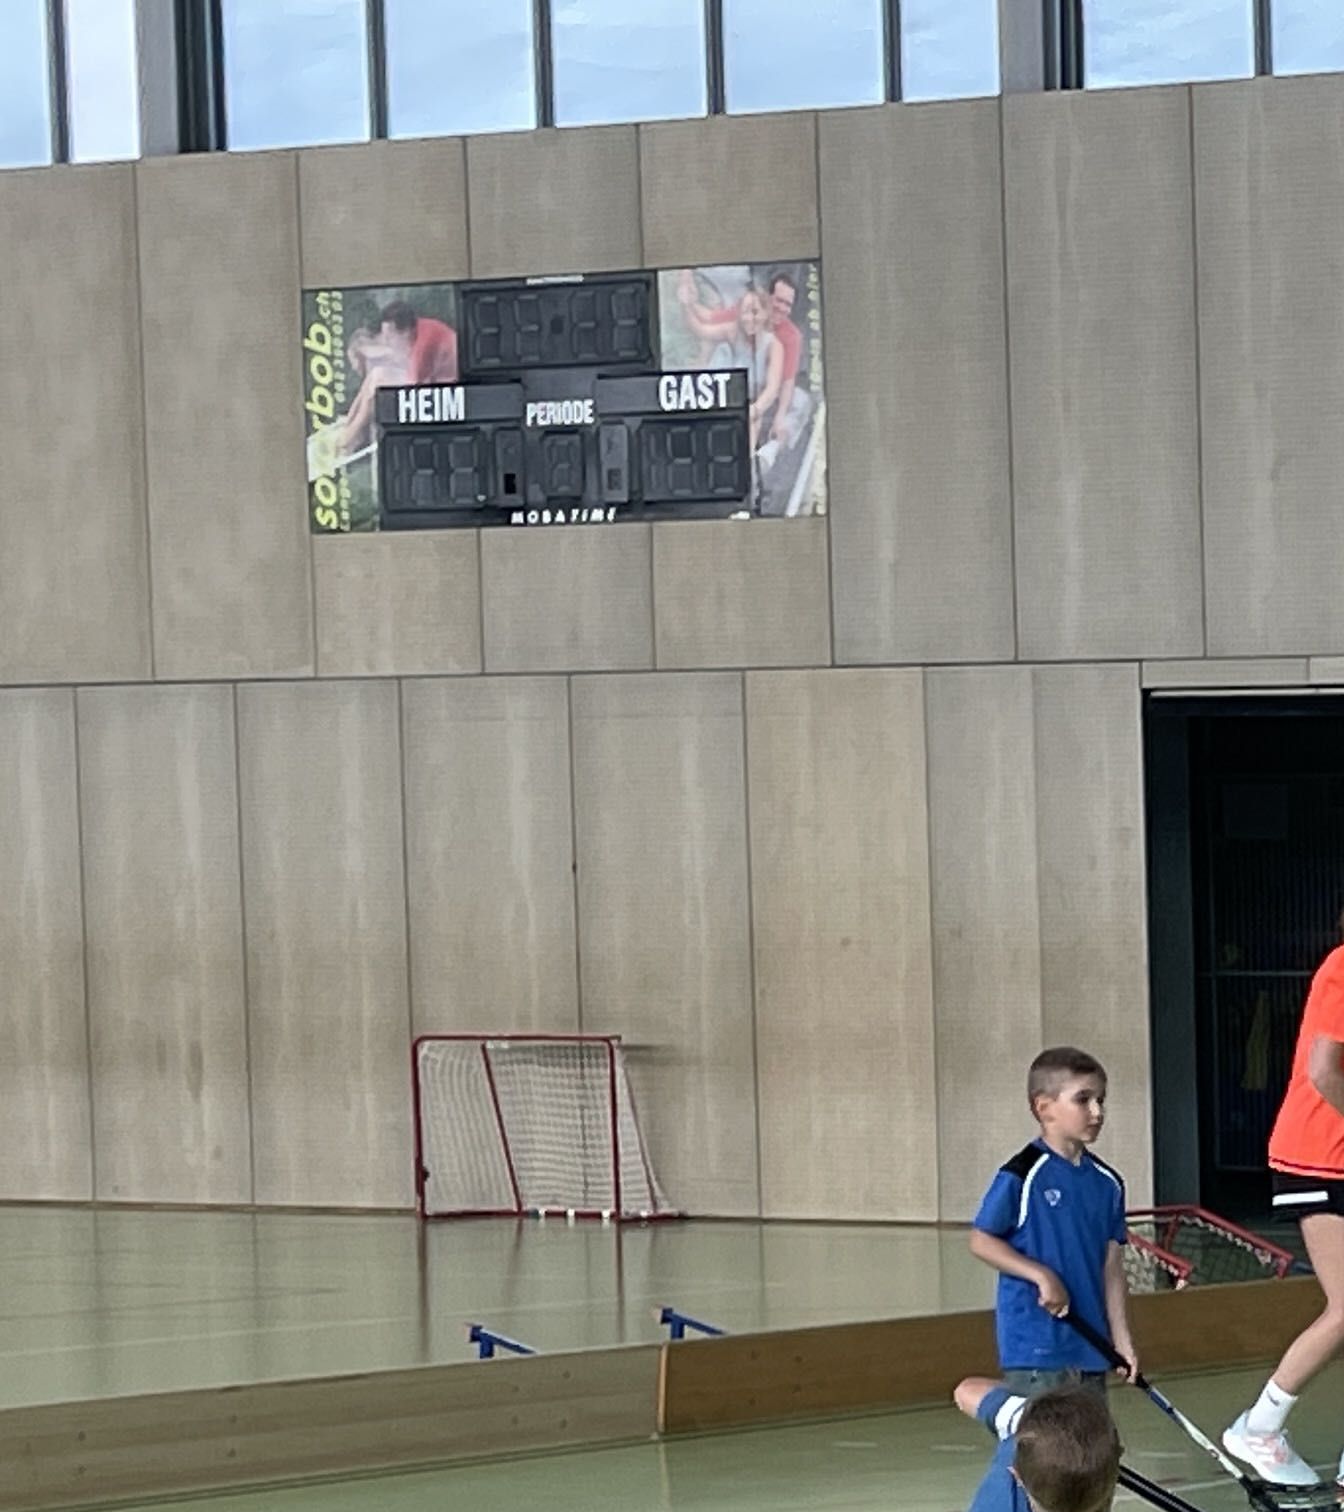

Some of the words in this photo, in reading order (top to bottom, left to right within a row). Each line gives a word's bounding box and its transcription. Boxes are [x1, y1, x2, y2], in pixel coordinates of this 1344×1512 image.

[304, 291, 339, 530] sorbob.ch
[398, 387, 466, 424] HEIM
[659, 373, 732, 411] GAST
[526, 399, 595, 427] PERIODE
